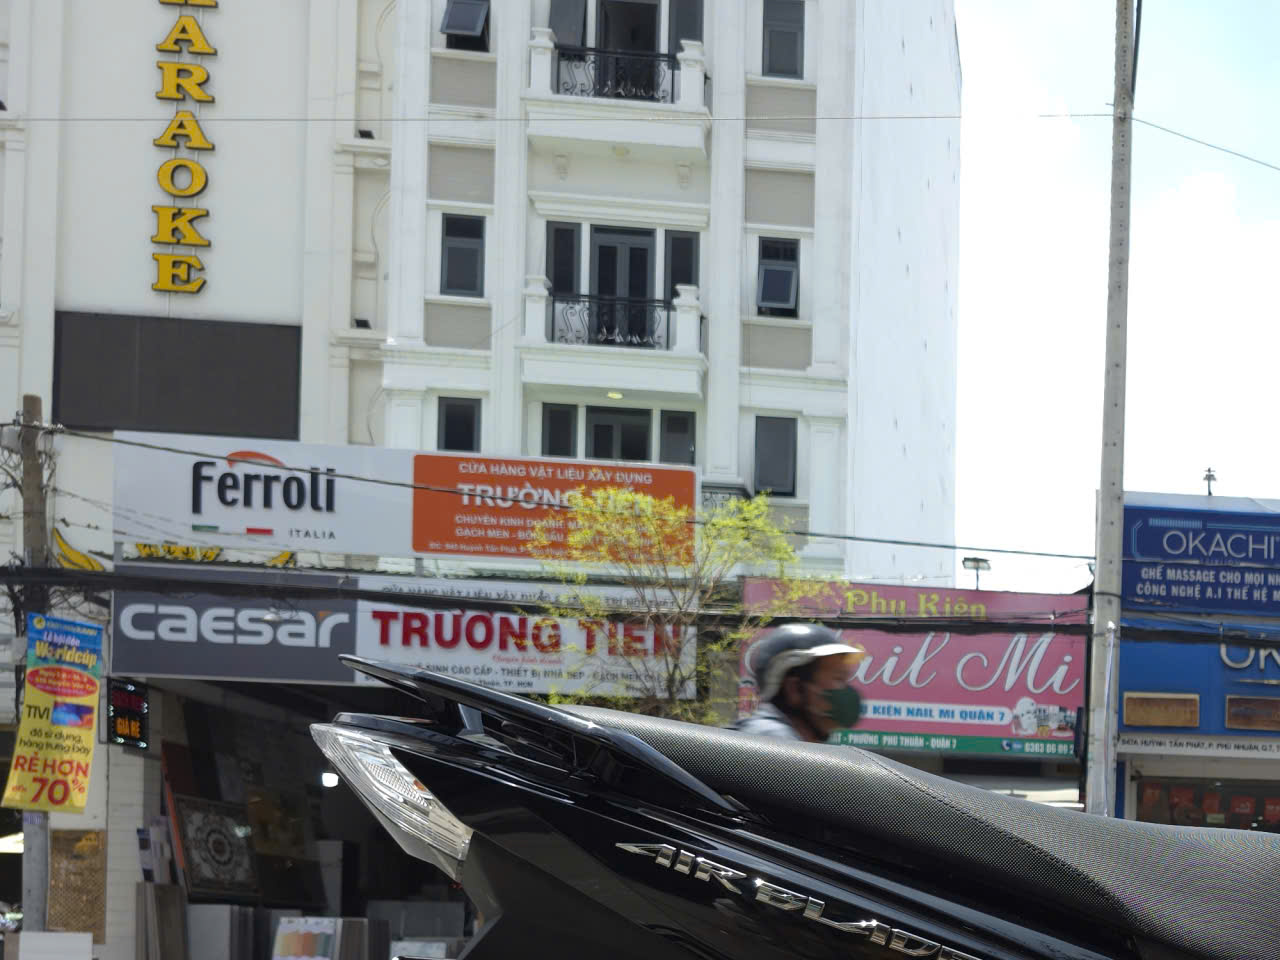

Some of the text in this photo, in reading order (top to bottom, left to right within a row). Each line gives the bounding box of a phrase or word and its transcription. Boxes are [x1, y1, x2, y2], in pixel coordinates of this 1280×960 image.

[151, 0, 217, 294] ARAOKE
[289, 528, 337, 541] ITALIA
[1162, 530, 1275, 560] OKACHI
[1166, 567, 1216, 583] MASSAGE
[1219, 571, 1242, 584] CHO
